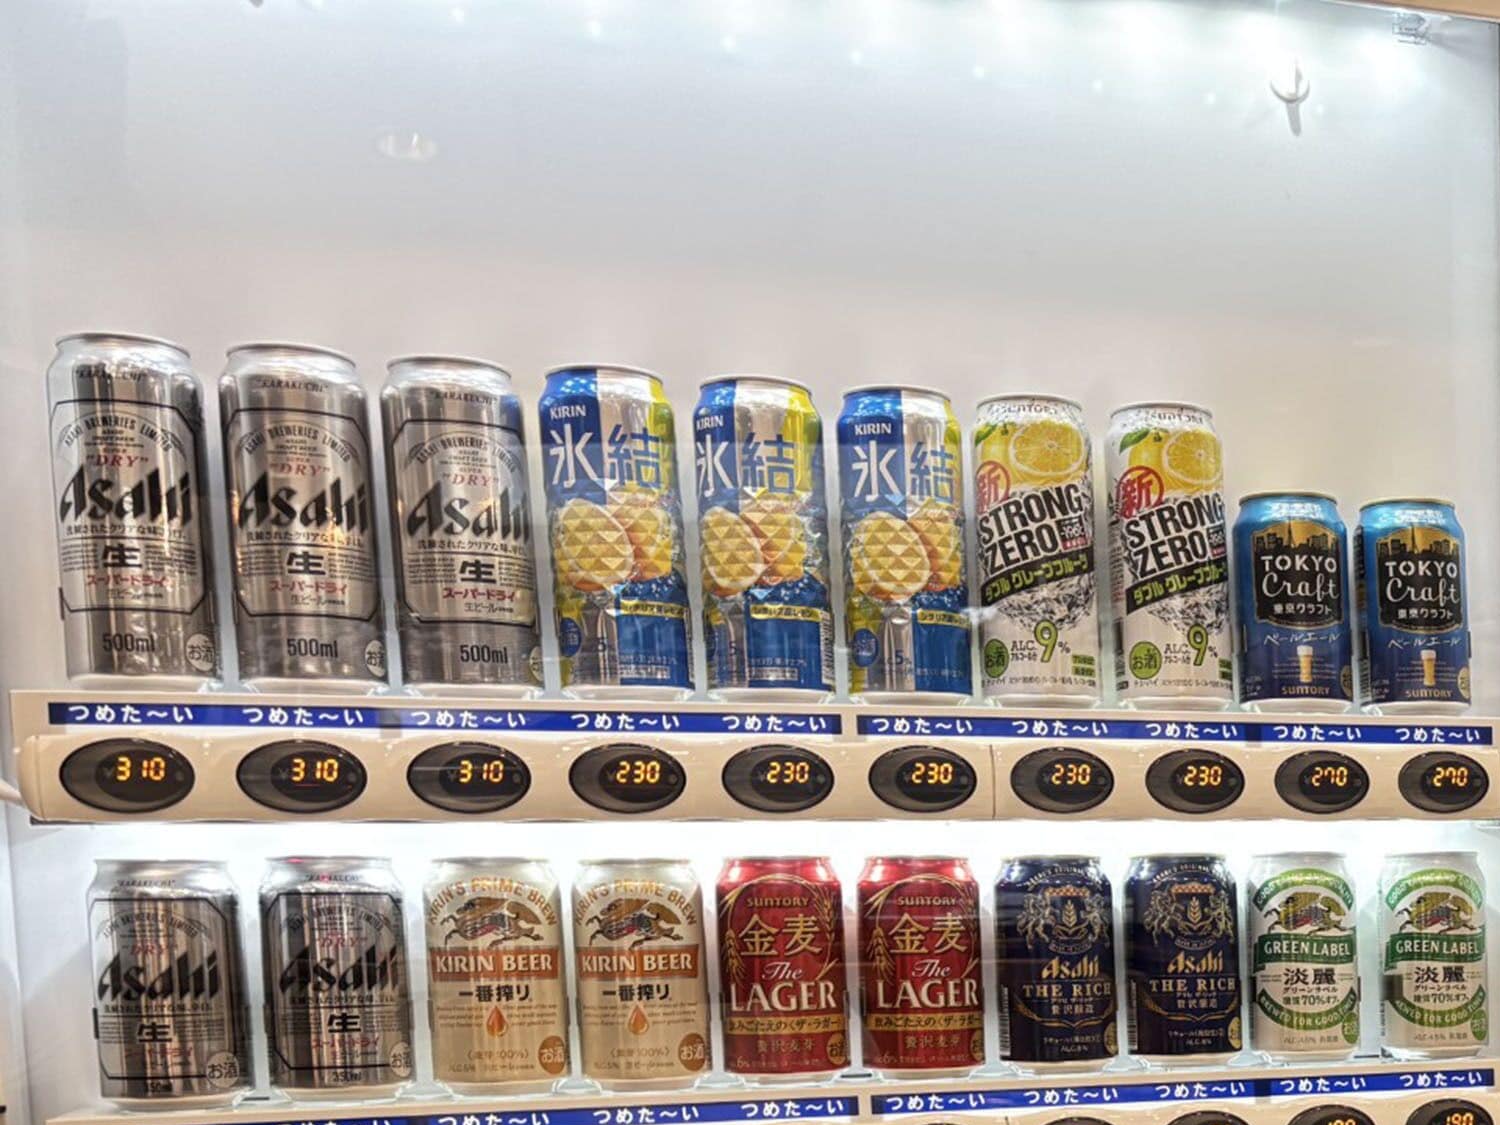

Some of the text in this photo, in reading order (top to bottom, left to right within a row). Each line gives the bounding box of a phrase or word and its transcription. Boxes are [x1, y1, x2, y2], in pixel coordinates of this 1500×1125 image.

[550, 406, 586, 419] KIRIN
[855, 422, 891, 436] KIRIN
[550, 423, 662, 490] 氷結
[696, 432, 796, 496] 氷結
[852, 440, 957, 503] 氷結
[60, 466, 191, 527] Asahi
[239, 472, 366, 533] Asahi
[407, 481, 530, 542] Asahi
[979, 484, 1083, 545] STRONG
[986, 524, 1058, 572] ZERO
[287, 552, 326, 575] 生
[459, 560, 496, 583] 生
[1261, 555, 1337, 573] TOKYO
[1385, 560, 1458, 578] TOKYO
[1262, 572, 1339, 601] Craft
[1386, 578, 1459, 606] Craft
[287, 638, 337, 658] 500ml
[460, 645, 508, 664] 500ml
[116, 756, 166, 781] 310
[460, 760, 504, 784] 310
[616, 760, 661, 784] 230
[911, 762, 953, 784] 230
[1183, 765, 1223, 786] 230
[1432, 767, 1468, 788] 270
[747, 897, 808, 908] SUNTORY
[739, 913, 823, 956] 金麦
[1264, 941, 1351, 956] GREEN LABEL
[435, 953, 552, 973] KIRIN BEER
[582, 953, 693, 972] KIRIN BEER
[762, 961, 804, 979] The
[1167, 950, 1223, 974] Asahi
[98, 950, 218, 1001] Asahi
[1150, 978, 1236, 992] THE RICH
[459, 984, 530, 1002] 一番搾り
[602, 984, 669, 1002] 一番搾り
[730, 978, 837, 1012] LAGER
